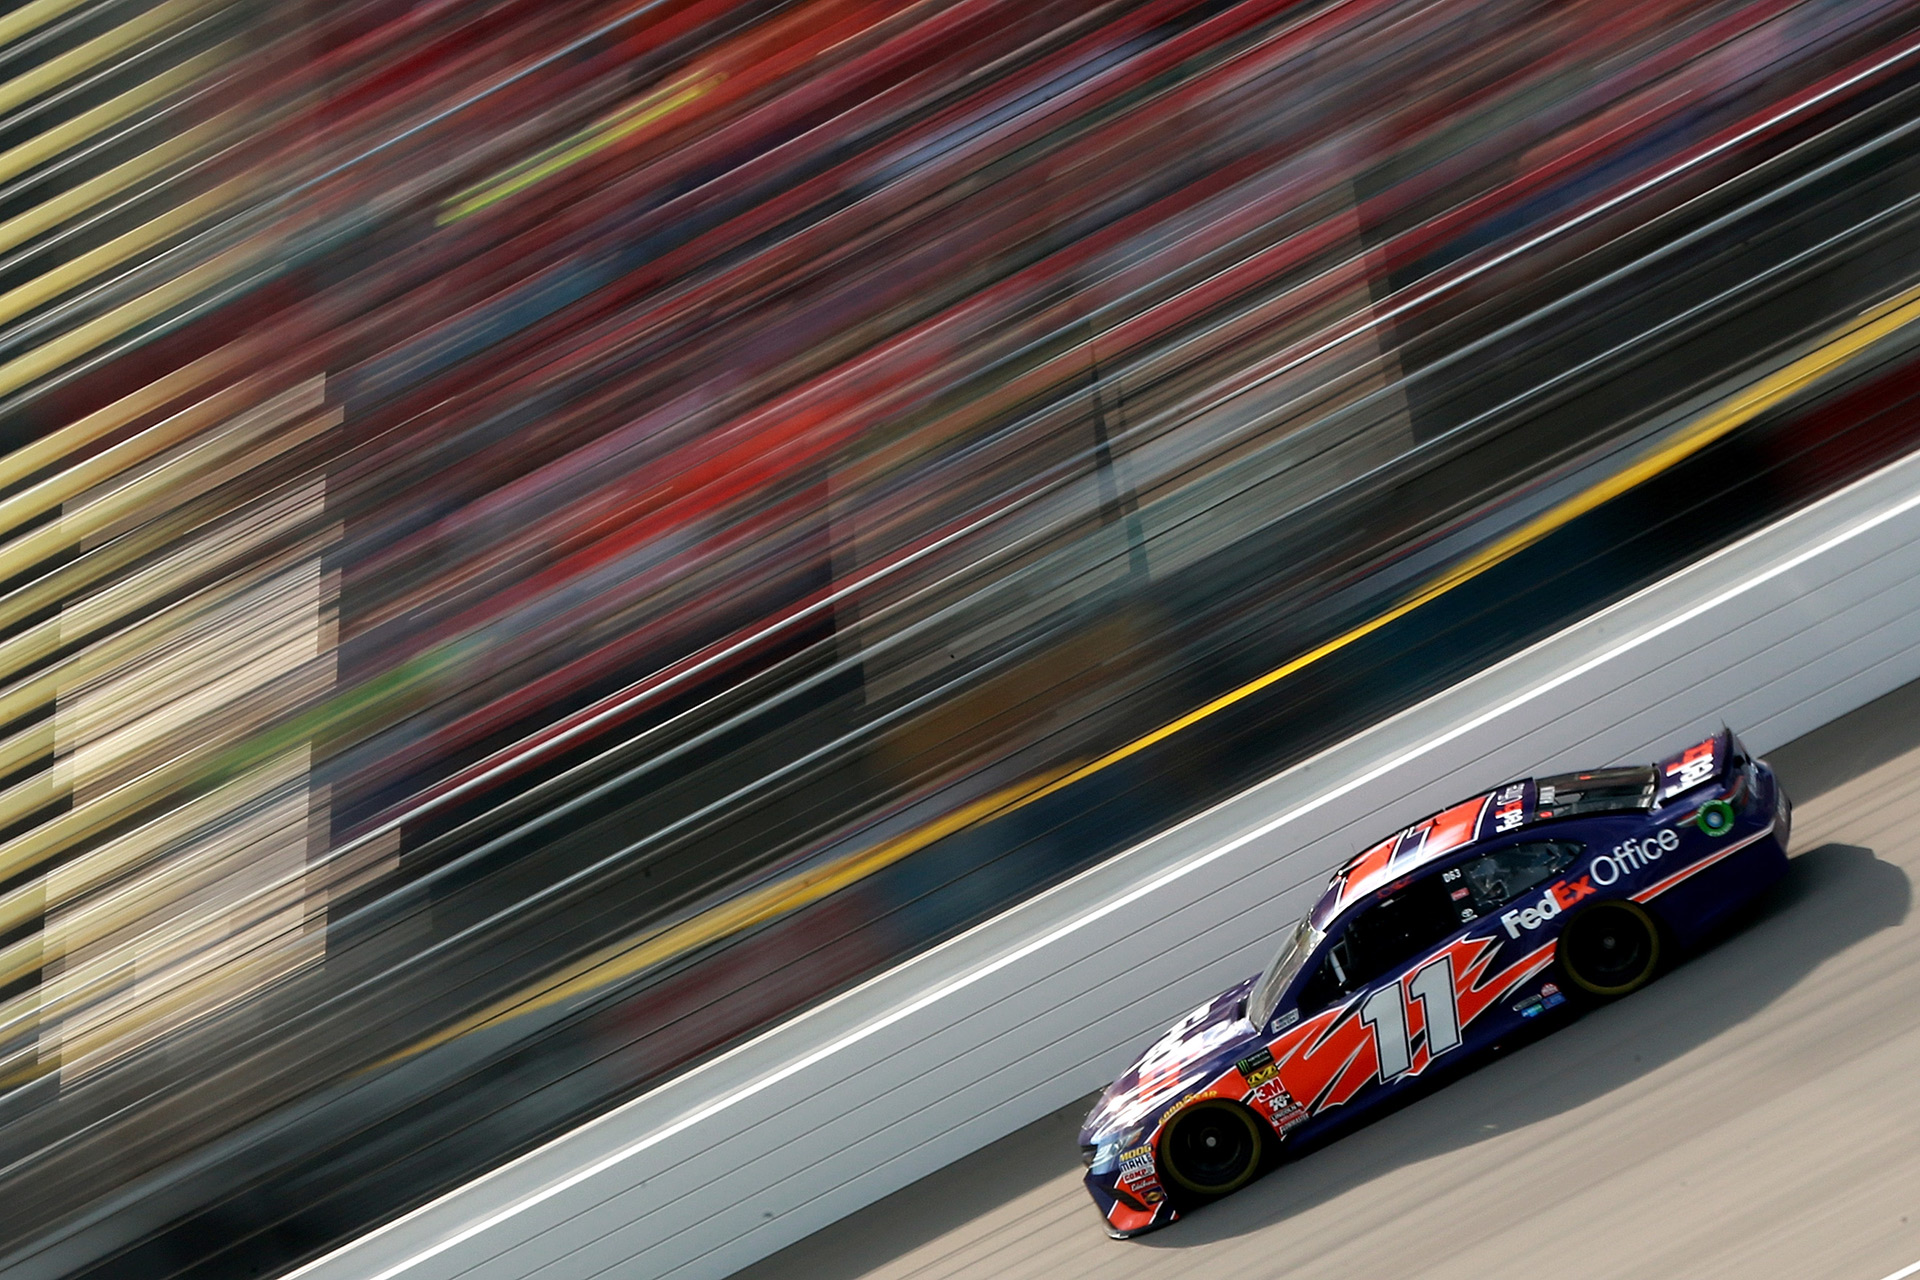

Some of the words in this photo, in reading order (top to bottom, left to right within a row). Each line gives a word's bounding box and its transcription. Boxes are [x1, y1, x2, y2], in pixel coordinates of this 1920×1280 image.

[1501, 875, 1597, 939] FedEx
[1590, 828, 1680, 886] Office
[1359, 952, 1463, 1085] 11
[1256, 1078, 1284, 1101] 3M
[1158, 1090, 1218, 1126] GOODYEAR
[1120, 1144, 1152, 1162] MOOG
[1121, 1153, 1153, 1172] MAHLE
